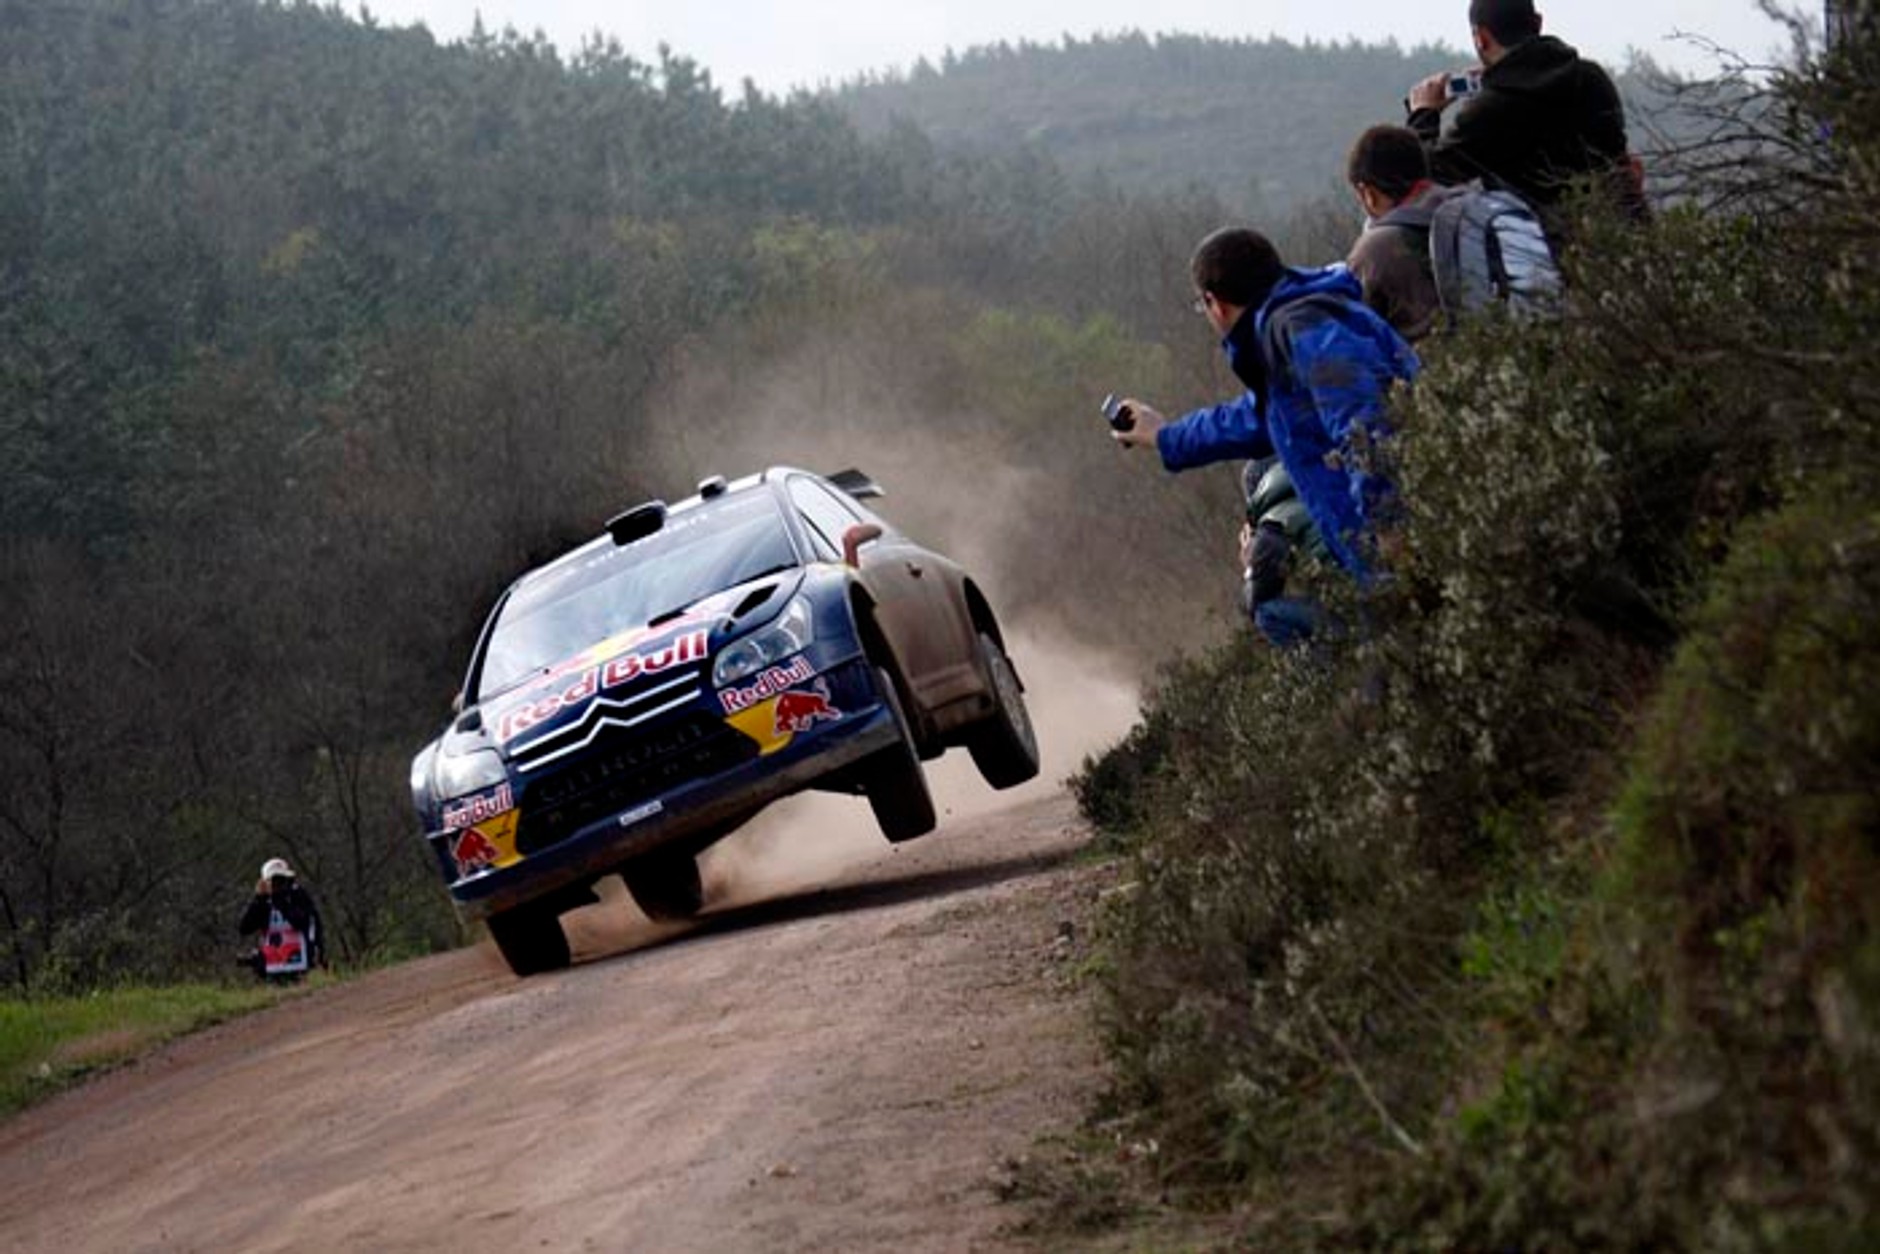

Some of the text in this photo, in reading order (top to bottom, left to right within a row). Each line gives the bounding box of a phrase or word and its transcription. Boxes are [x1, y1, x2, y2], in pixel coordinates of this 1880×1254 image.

[499, 630, 708, 743] Red Bull
[719, 654, 815, 714] Red Bull
[470, 783, 514, 824] Bull
